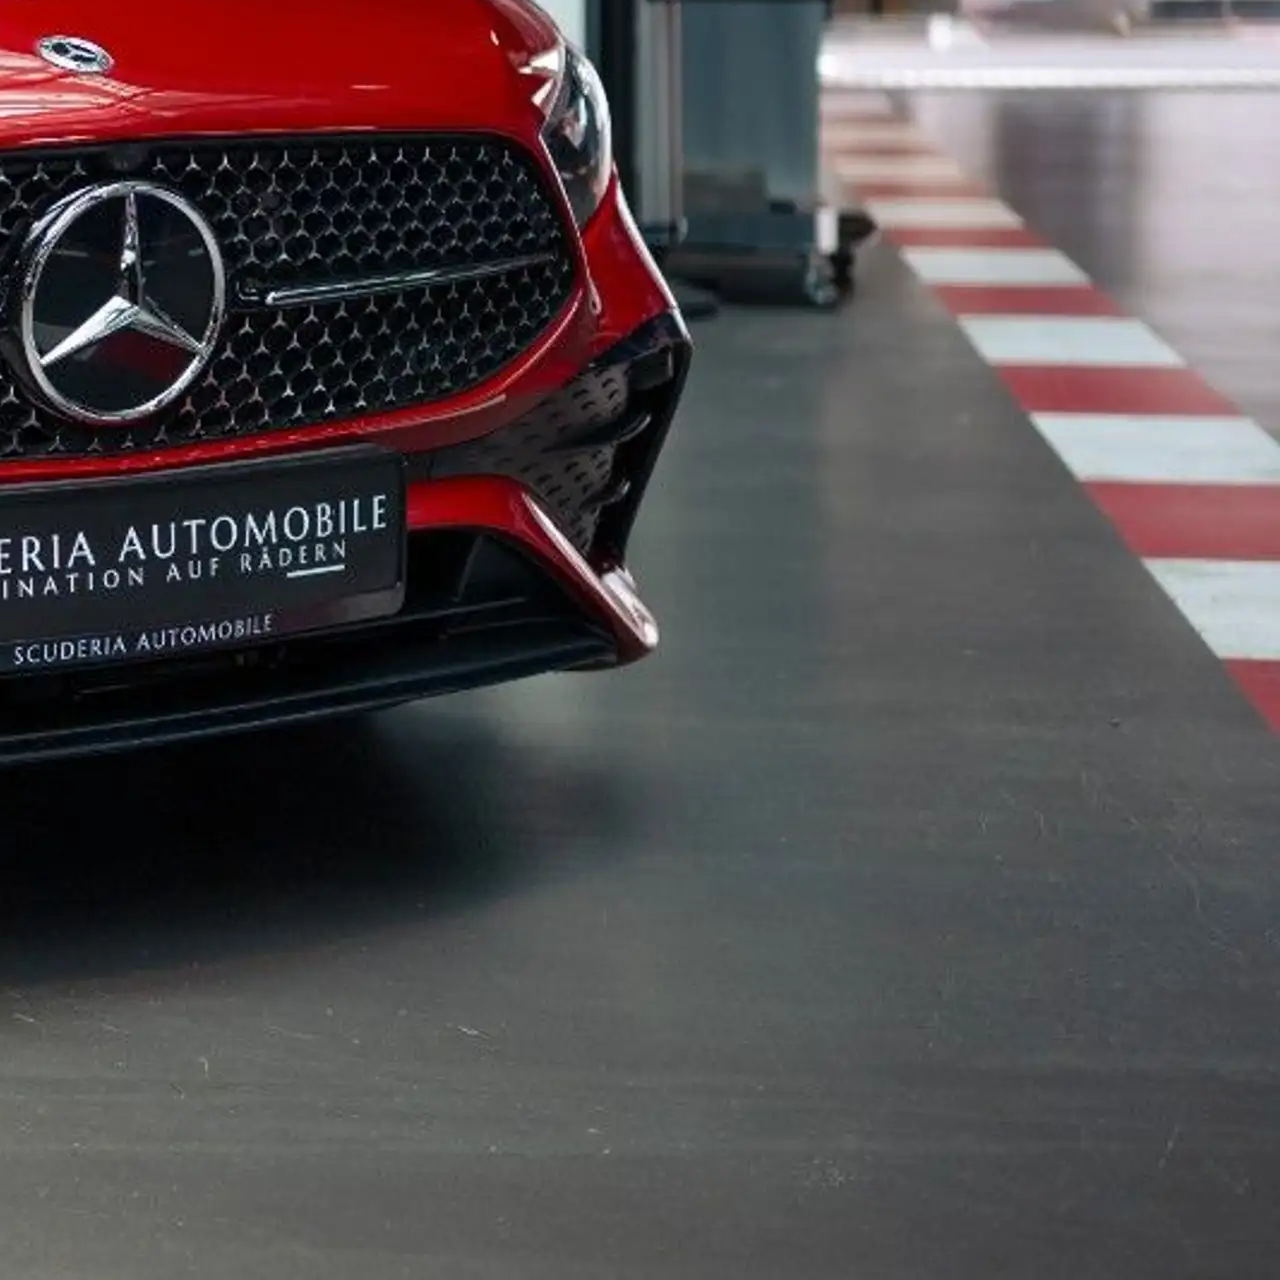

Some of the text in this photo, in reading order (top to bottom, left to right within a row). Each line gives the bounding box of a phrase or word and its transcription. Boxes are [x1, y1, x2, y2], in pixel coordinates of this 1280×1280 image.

[118, 494, 388, 563] AUTOMOBILE
[166, 557, 221, 583] AUF
[240, 539, 347, 574] RÄDERN
[12, 613, 273, 665] SCUDERIA AUTOMOBILE
